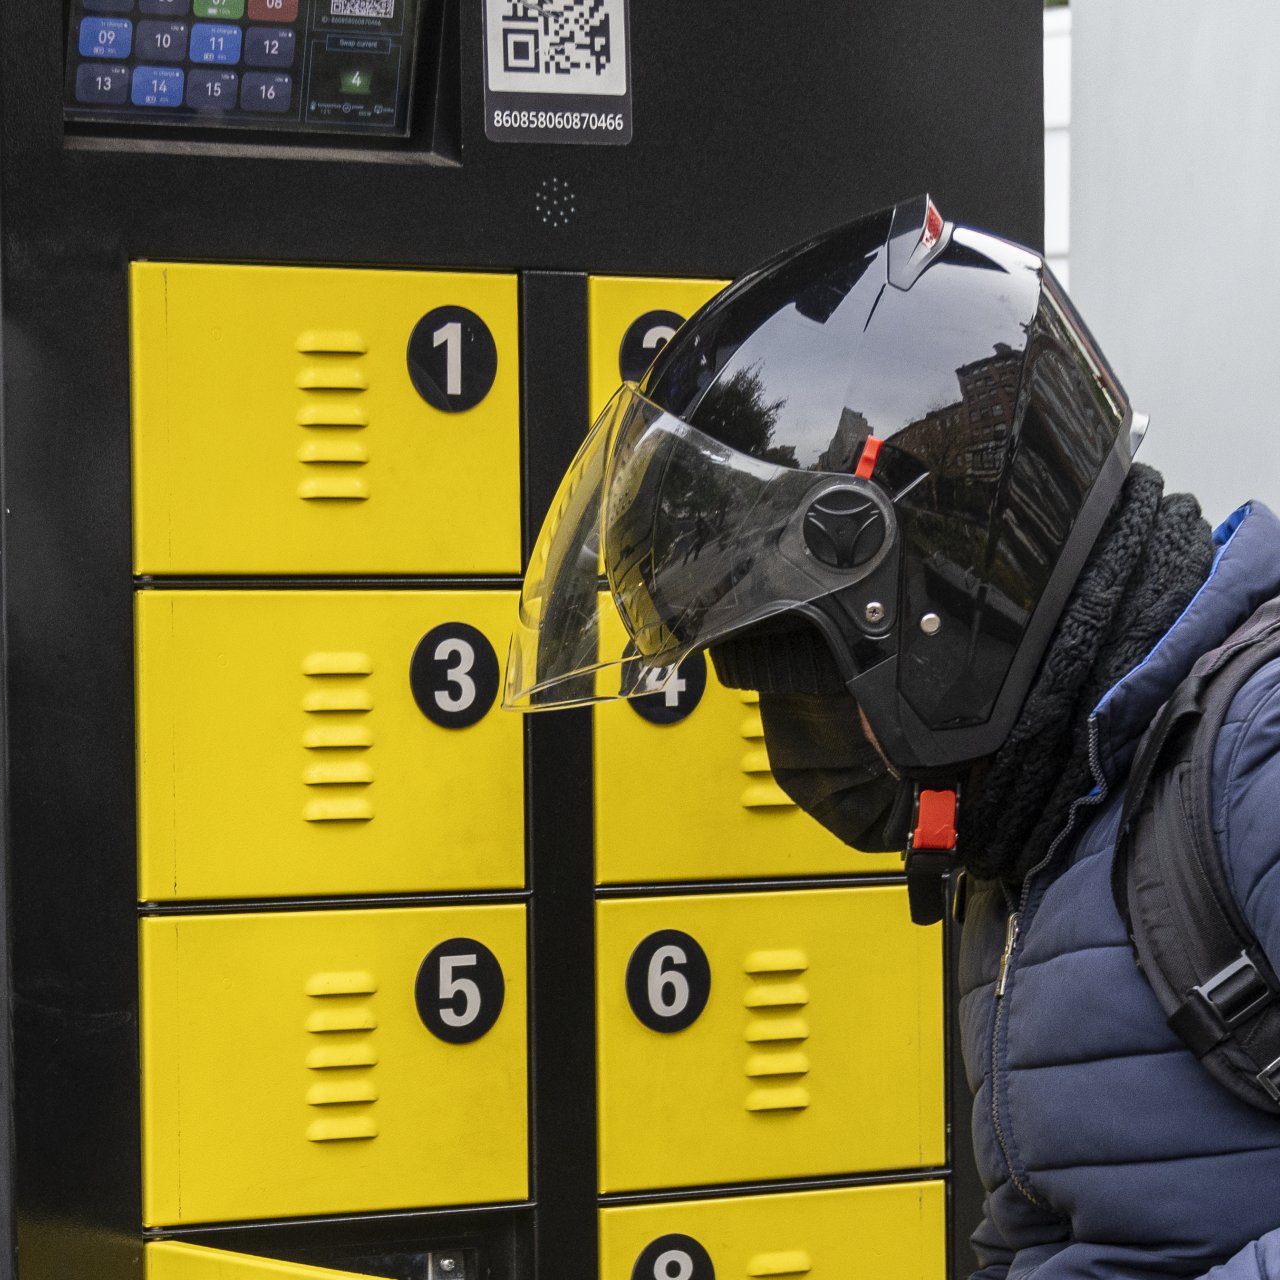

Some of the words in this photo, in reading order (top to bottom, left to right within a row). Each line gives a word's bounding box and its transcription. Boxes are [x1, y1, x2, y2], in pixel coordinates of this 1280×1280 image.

[98, 30, 116, 45] 09
[155, 33, 171, 48] 10
[209, 37, 224, 51] 11
[263, 40, 279, 55] 12
[95, 76, 112, 91] 13
[151, 79, 167, 93] 14
[206, 82, 222, 97] 15
[260, 85, 275, 100] 16
[351, 71, 362, 87] 4
[493, 110, 624, 131] 860858060870466
[433, 322, 462, 395] 1
[434, 638, 476, 712] 3
[439, 954, 481, 1027] 5
[647, 945, 689, 1017] 6
